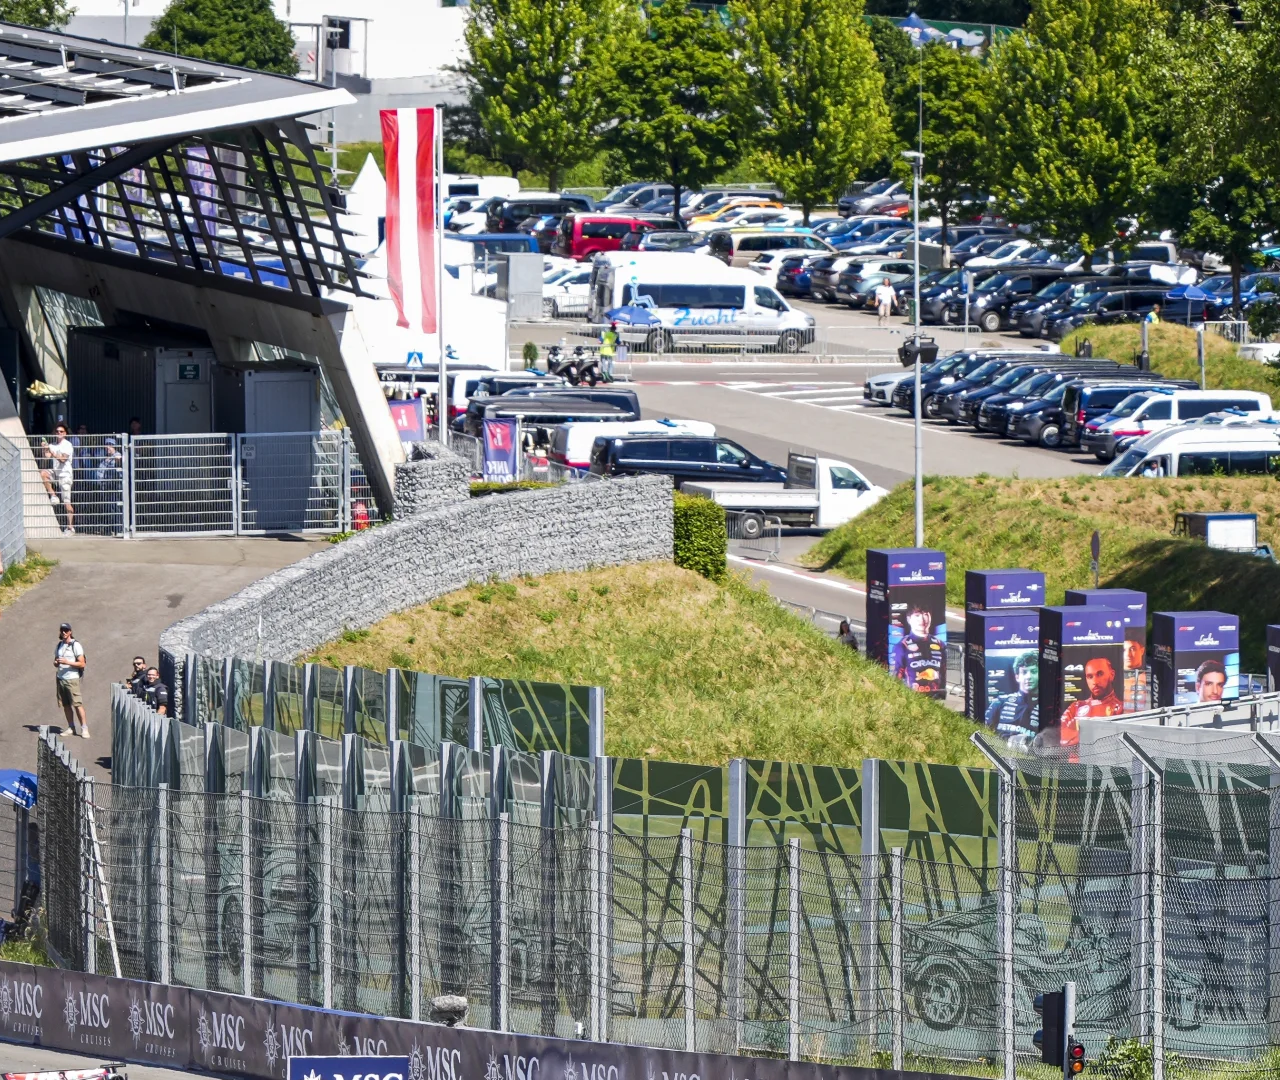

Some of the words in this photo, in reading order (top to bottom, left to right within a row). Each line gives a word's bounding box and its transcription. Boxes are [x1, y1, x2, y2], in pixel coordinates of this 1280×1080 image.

[988, 669, 1005, 677] 12
[1178, 668, 1196, 676] 55
[13, 981, 43, 1018] MSC
[80, 992, 110, 1028] MSC
[146, 1001, 175, 1038] MSC
[13, 1022, 43, 1036] CRUISES
[212, 1012, 245, 1051] MSC
[80, 1034, 111, 1046] CRUISES
[281, 1024, 313, 1056] MSC
[145, 1043, 175, 1057] CRUISES
[211, 1056, 246, 1069] CRUISES
